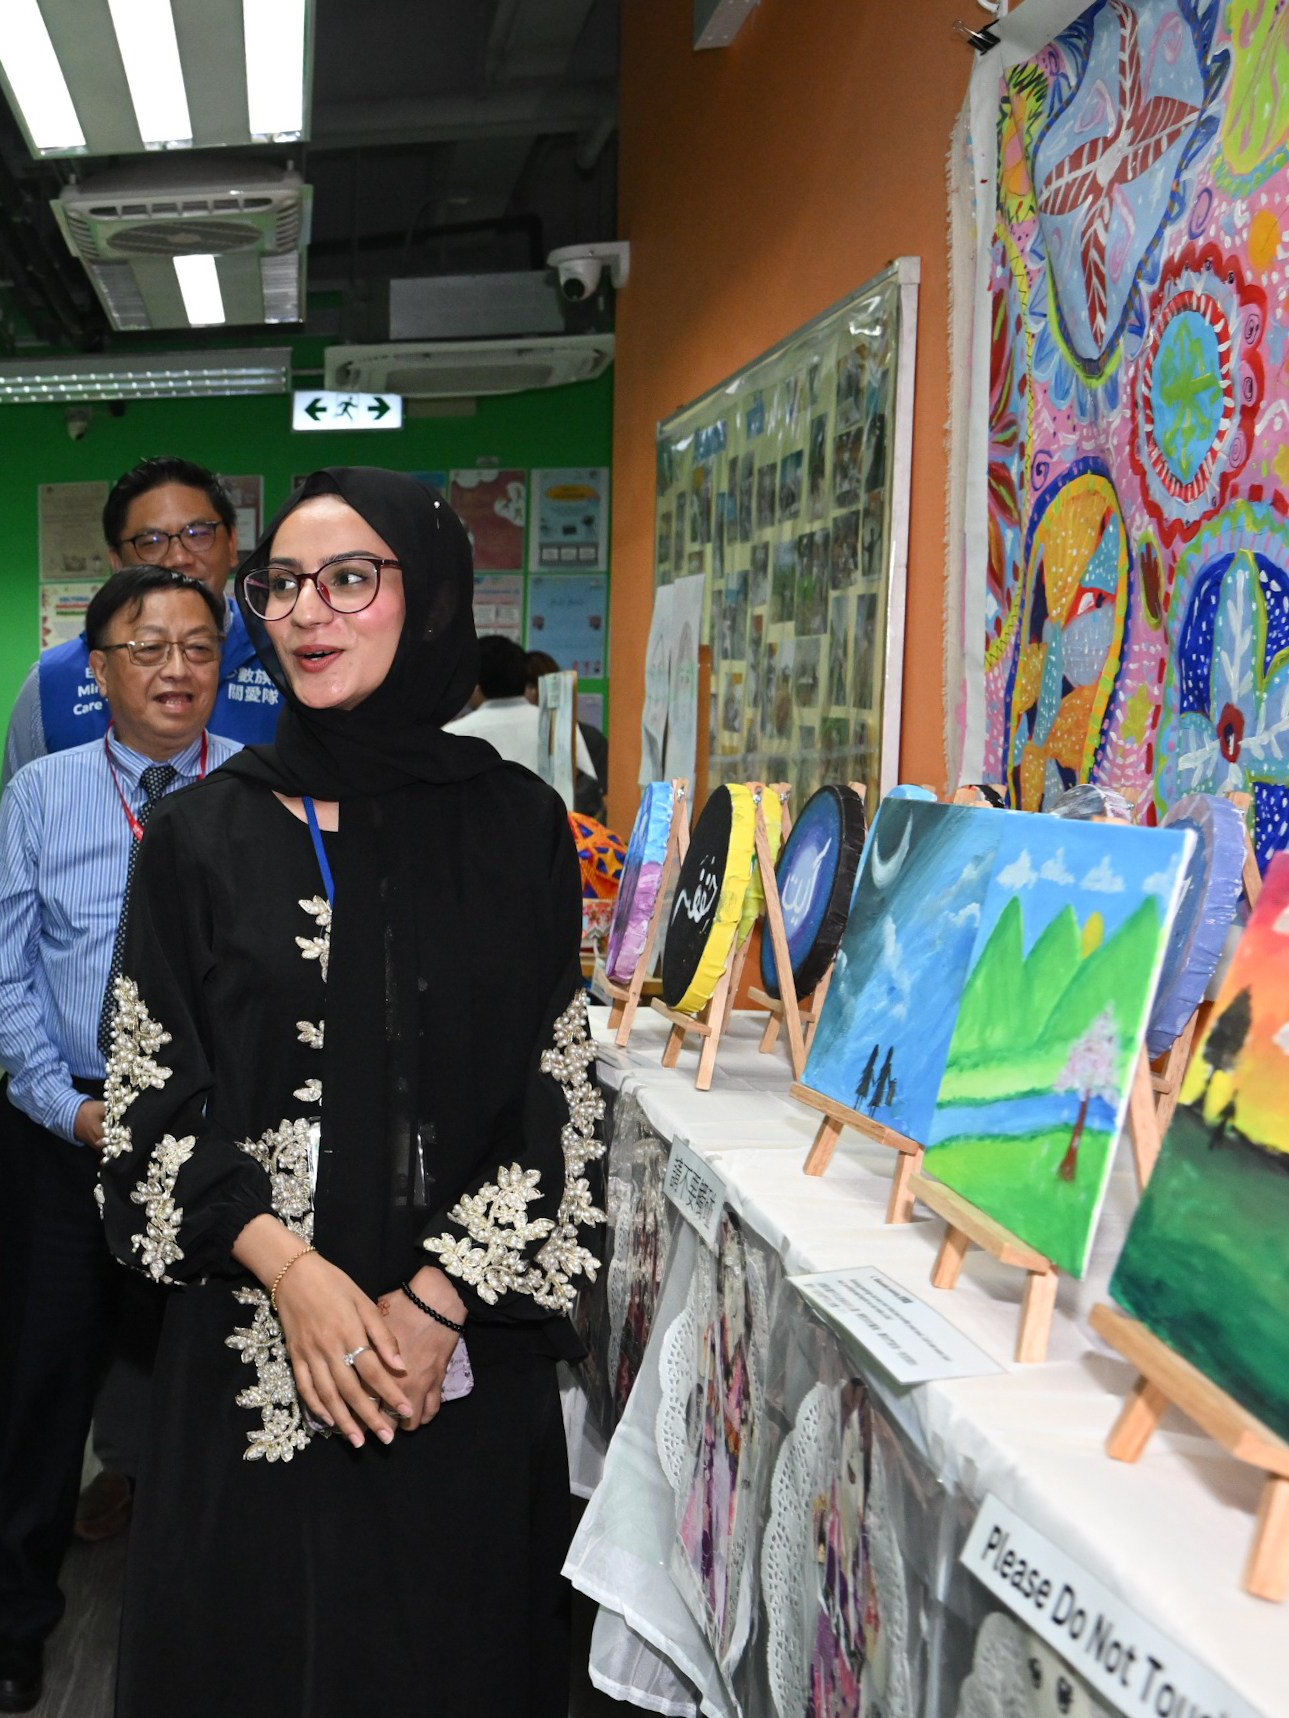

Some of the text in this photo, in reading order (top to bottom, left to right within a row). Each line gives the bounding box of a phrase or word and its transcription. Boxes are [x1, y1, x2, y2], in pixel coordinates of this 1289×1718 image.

[228, 683, 279, 706] 關愛隊
[73, 701, 103, 716] Care
[980, 1524, 1230, 1718] Please Do Not Tou
